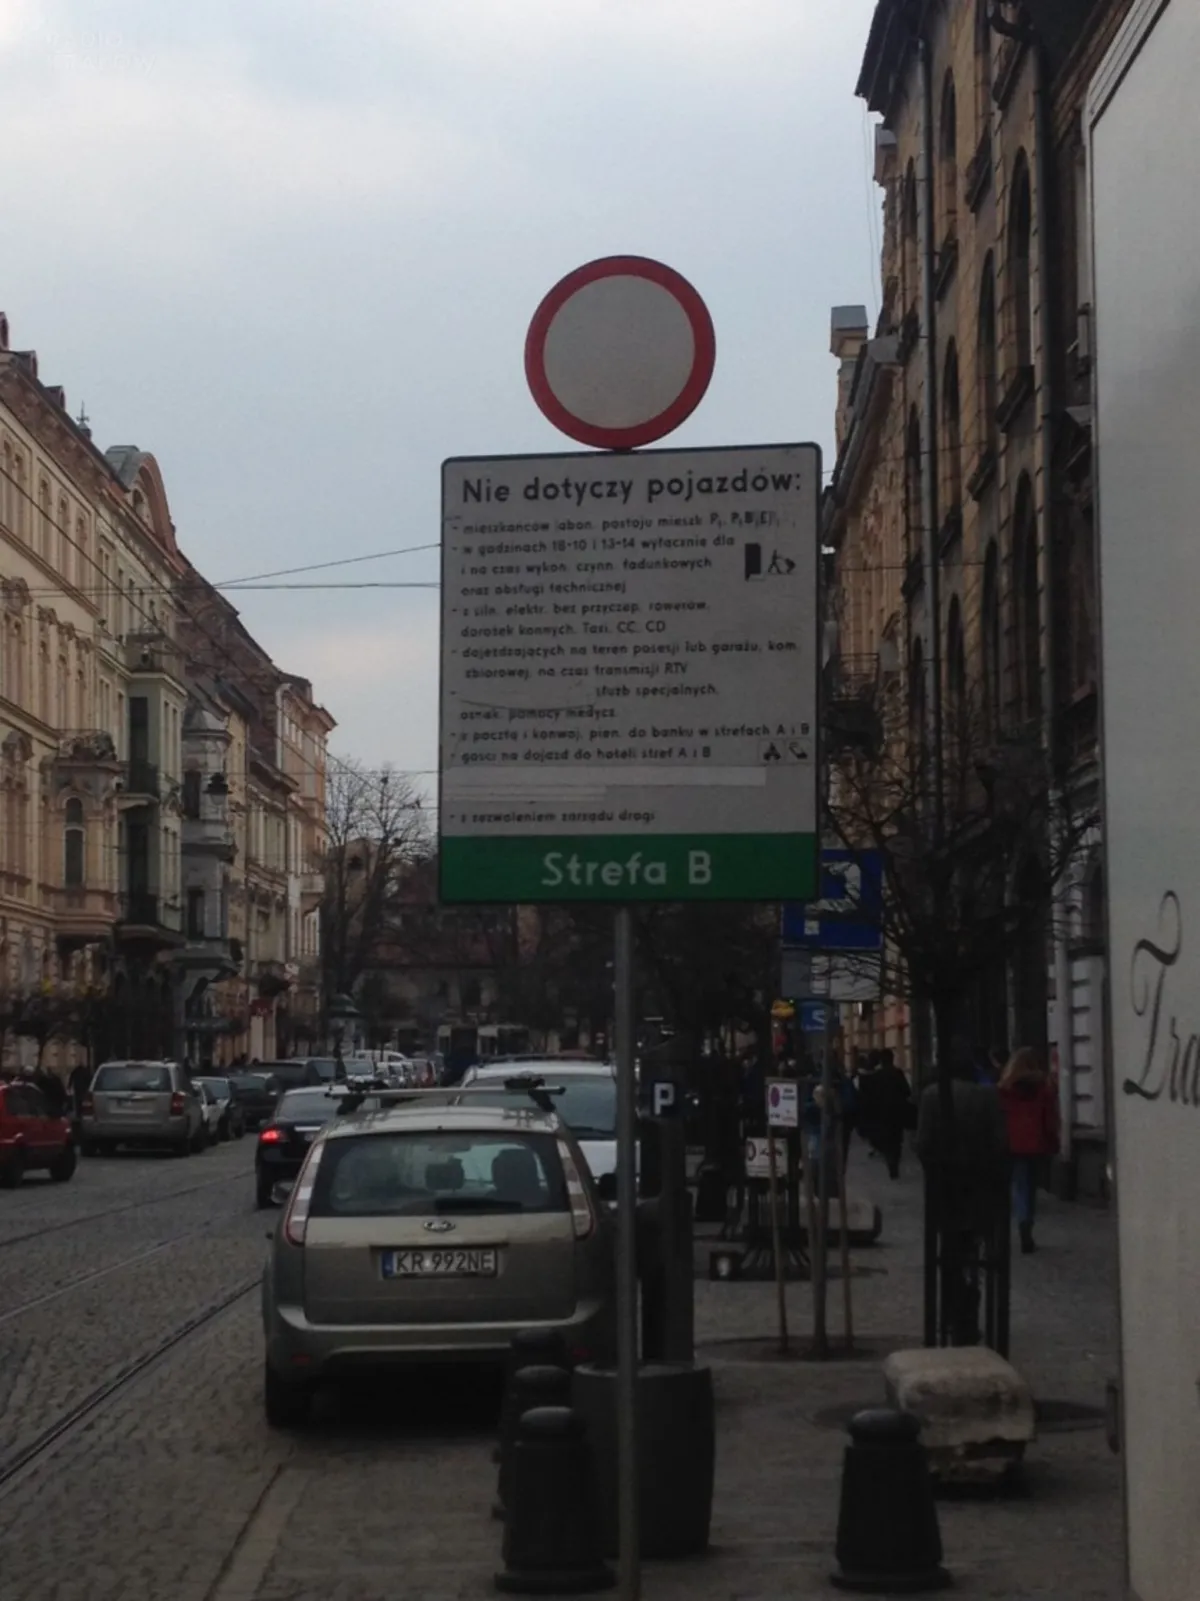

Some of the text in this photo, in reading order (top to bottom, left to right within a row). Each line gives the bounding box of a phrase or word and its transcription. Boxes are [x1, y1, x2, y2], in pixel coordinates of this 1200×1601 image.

[463, 467, 801, 505] Nie dotyczy pojazdów:
[478, 541, 547, 558] godzinach
[712, 534, 736, 547] dla
[470, 565, 488, 575] na
[492, 564, 522, 575] czas
[461, 586, 489, 597] oraz
[549, 580, 626, 596] technicznej
[553, 602, 576, 614] bez
[645, 619, 667, 634] CD
[570, 646, 588, 656] na
[592, 644, 628, 656] teren
[633, 642, 680, 658] posesji
[685, 640, 707, 653] lub
[537, 668, 556, 678] na
[560, 667, 589, 678] czas
[594, 663, 660, 679] transmisji
[664, 662, 688, 675] RTV
[628, 726, 646, 739] do
[651, 725, 694, 738] banku
[698, 728, 710, 737] w
[714, 723, 771, 737] strefach
[776, 723, 786, 736] A
[800, 722, 810, 735] B
[501, 752, 519, 761] na
[524, 748, 569, 763] dojazd
[574, 748, 592, 761] do
[596, 747, 637, 760] hoteli
[642, 746, 673, 759] stref
[677, 747, 688, 758] A
[702, 746, 712, 758] B
[472, 810, 557, 824] zezwoleniem
[619, 808, 656, 826] drogi
[542, 850, 712, 886] Strefa B
[653, 1082, 675, 1116] P
[396, 1250, 493, 1273] KR 992NE
